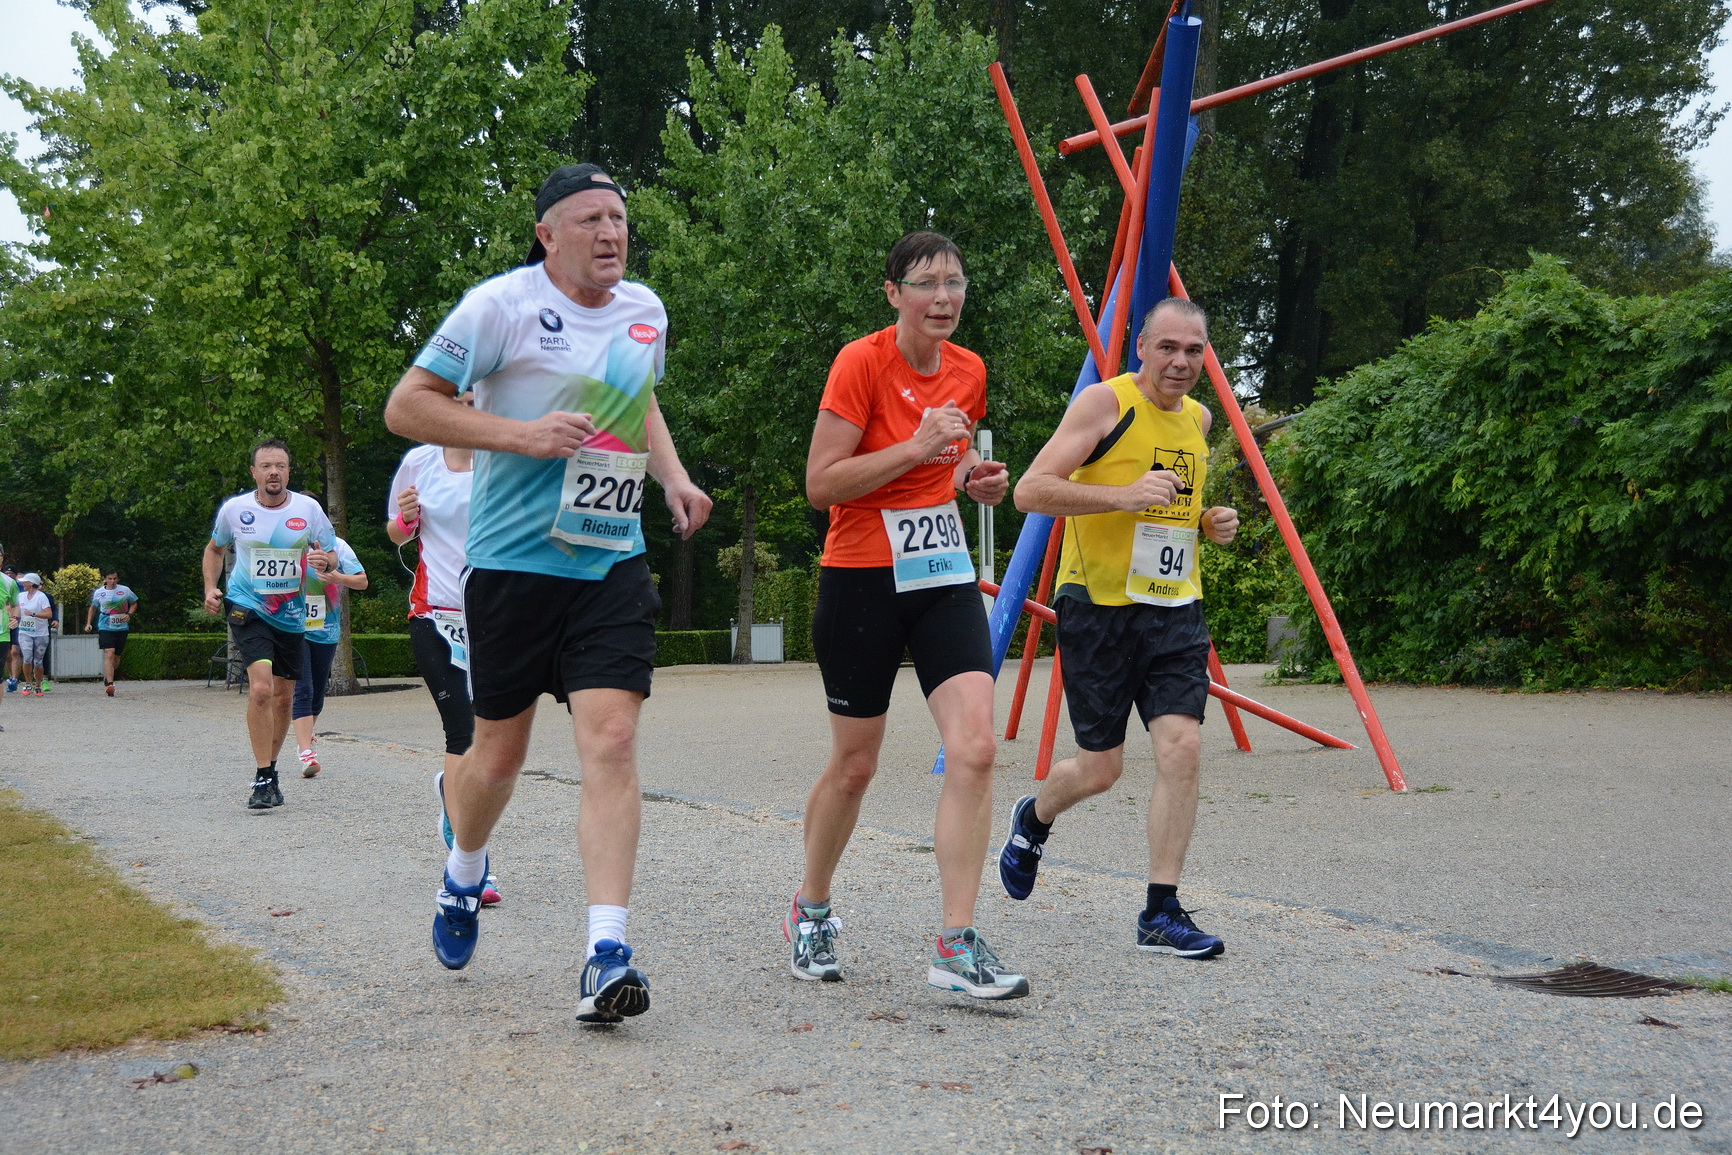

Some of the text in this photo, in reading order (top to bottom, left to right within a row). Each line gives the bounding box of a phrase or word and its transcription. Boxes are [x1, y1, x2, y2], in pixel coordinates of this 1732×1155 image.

[540, 337, 571, 347] PARTL
[940, 445, 959, 455] ers
[573, 473, 644, 513] 2202
[581, 518, 630, 537] Richard
[898, 514, 960, 553] 2298
[256, 559, 297, 577] 2871
[928, 558, 953, 574] Erika
[1158, 545, 1184, 577] 94
[266, 581, 289, 589] Robert
